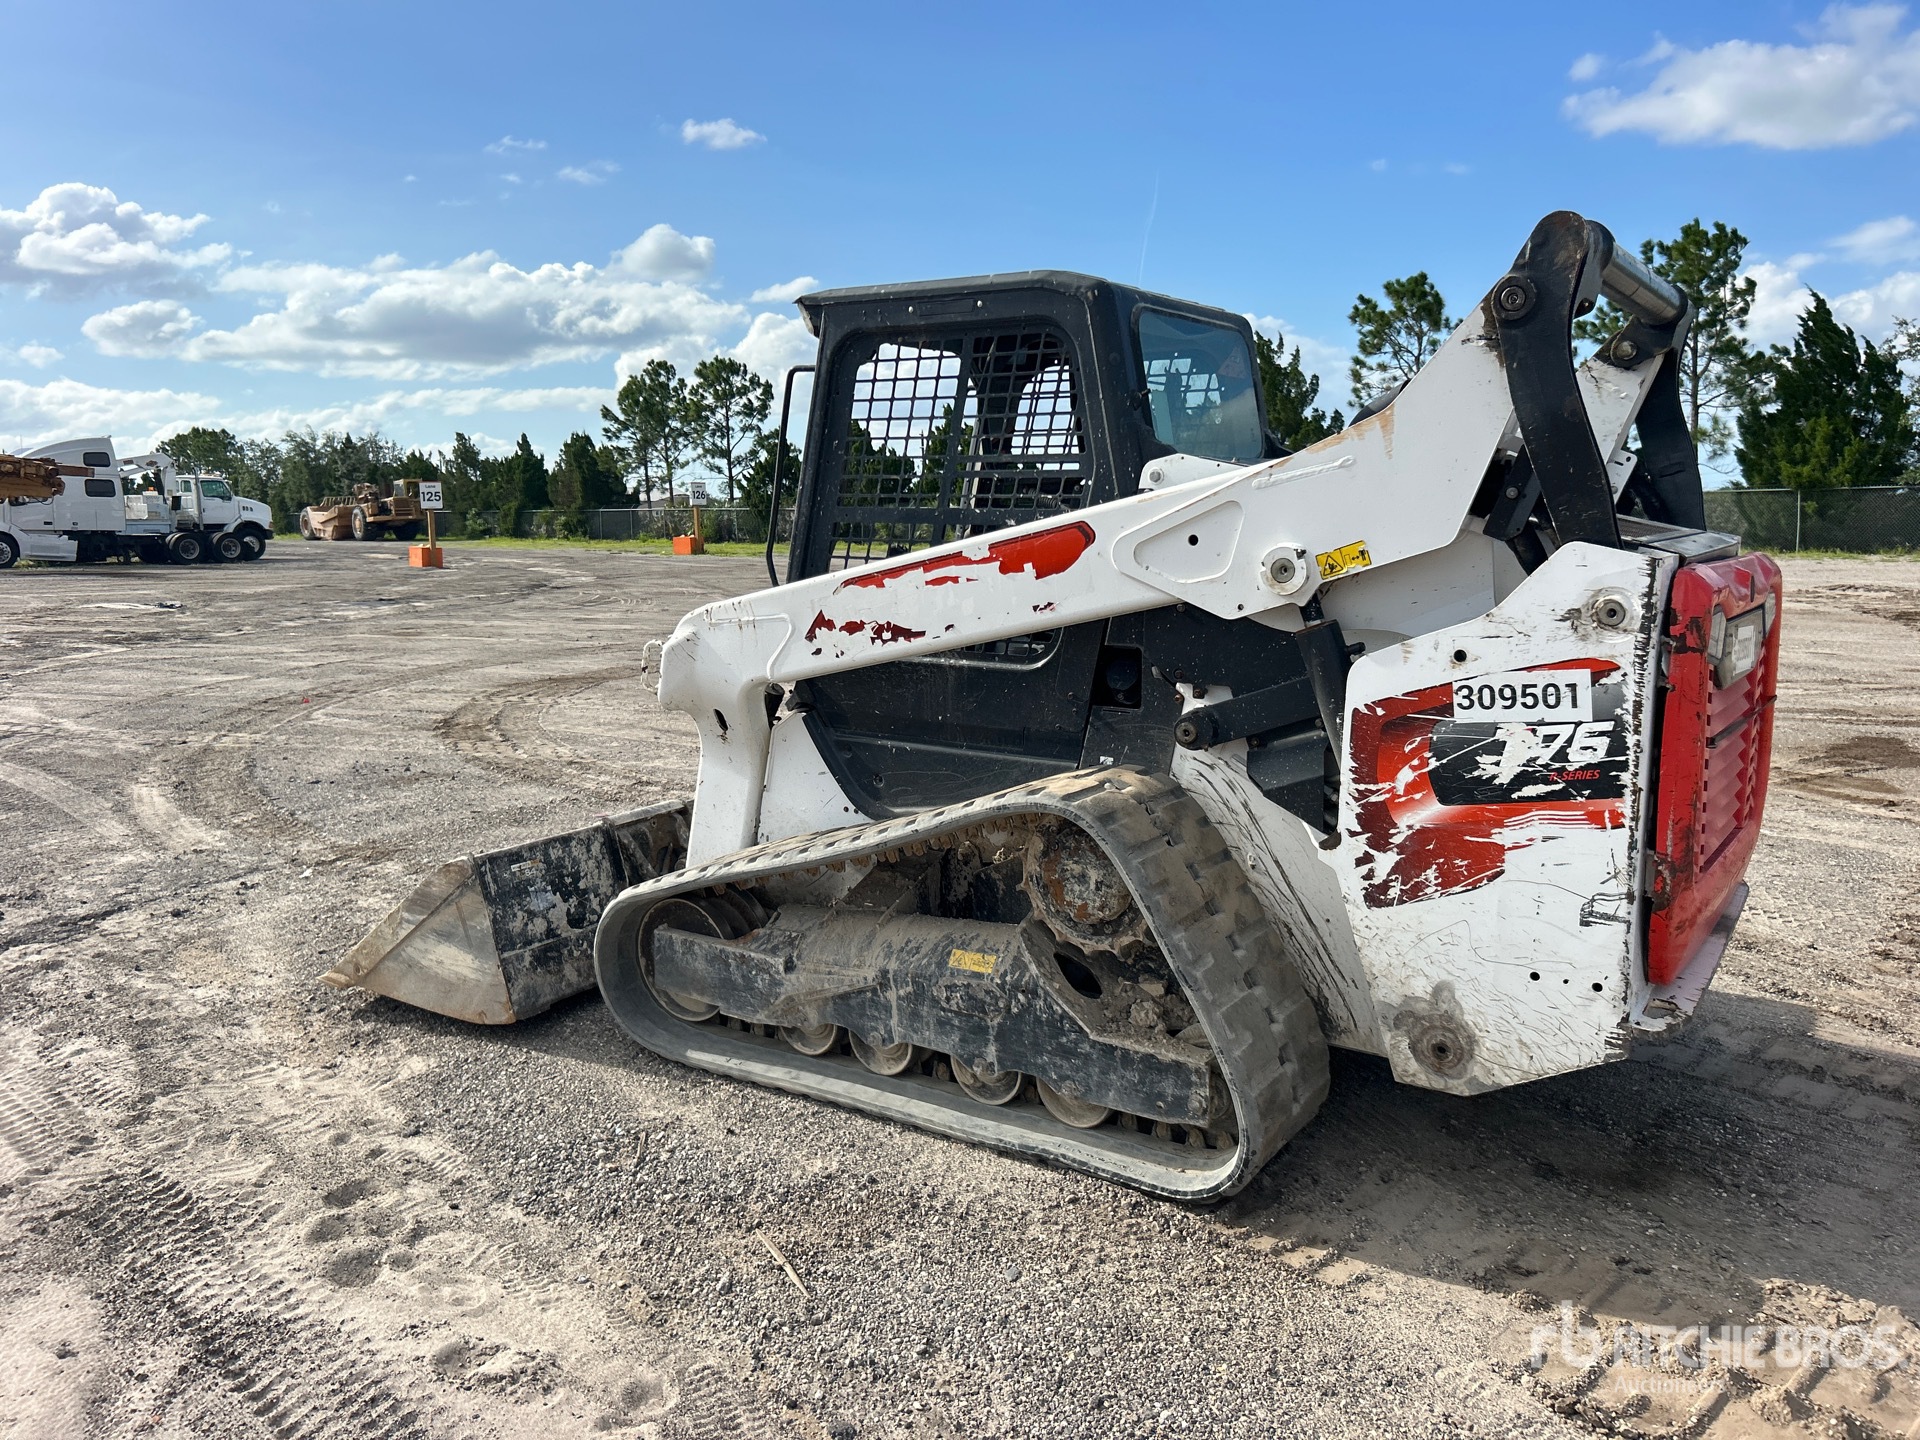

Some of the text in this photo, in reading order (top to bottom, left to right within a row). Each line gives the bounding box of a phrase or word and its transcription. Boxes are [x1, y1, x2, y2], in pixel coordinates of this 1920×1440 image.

[421, 491, 441, 501] 125
[692, 490, 705, 499] 126
[1454, 683, 1578, 711] 309501
